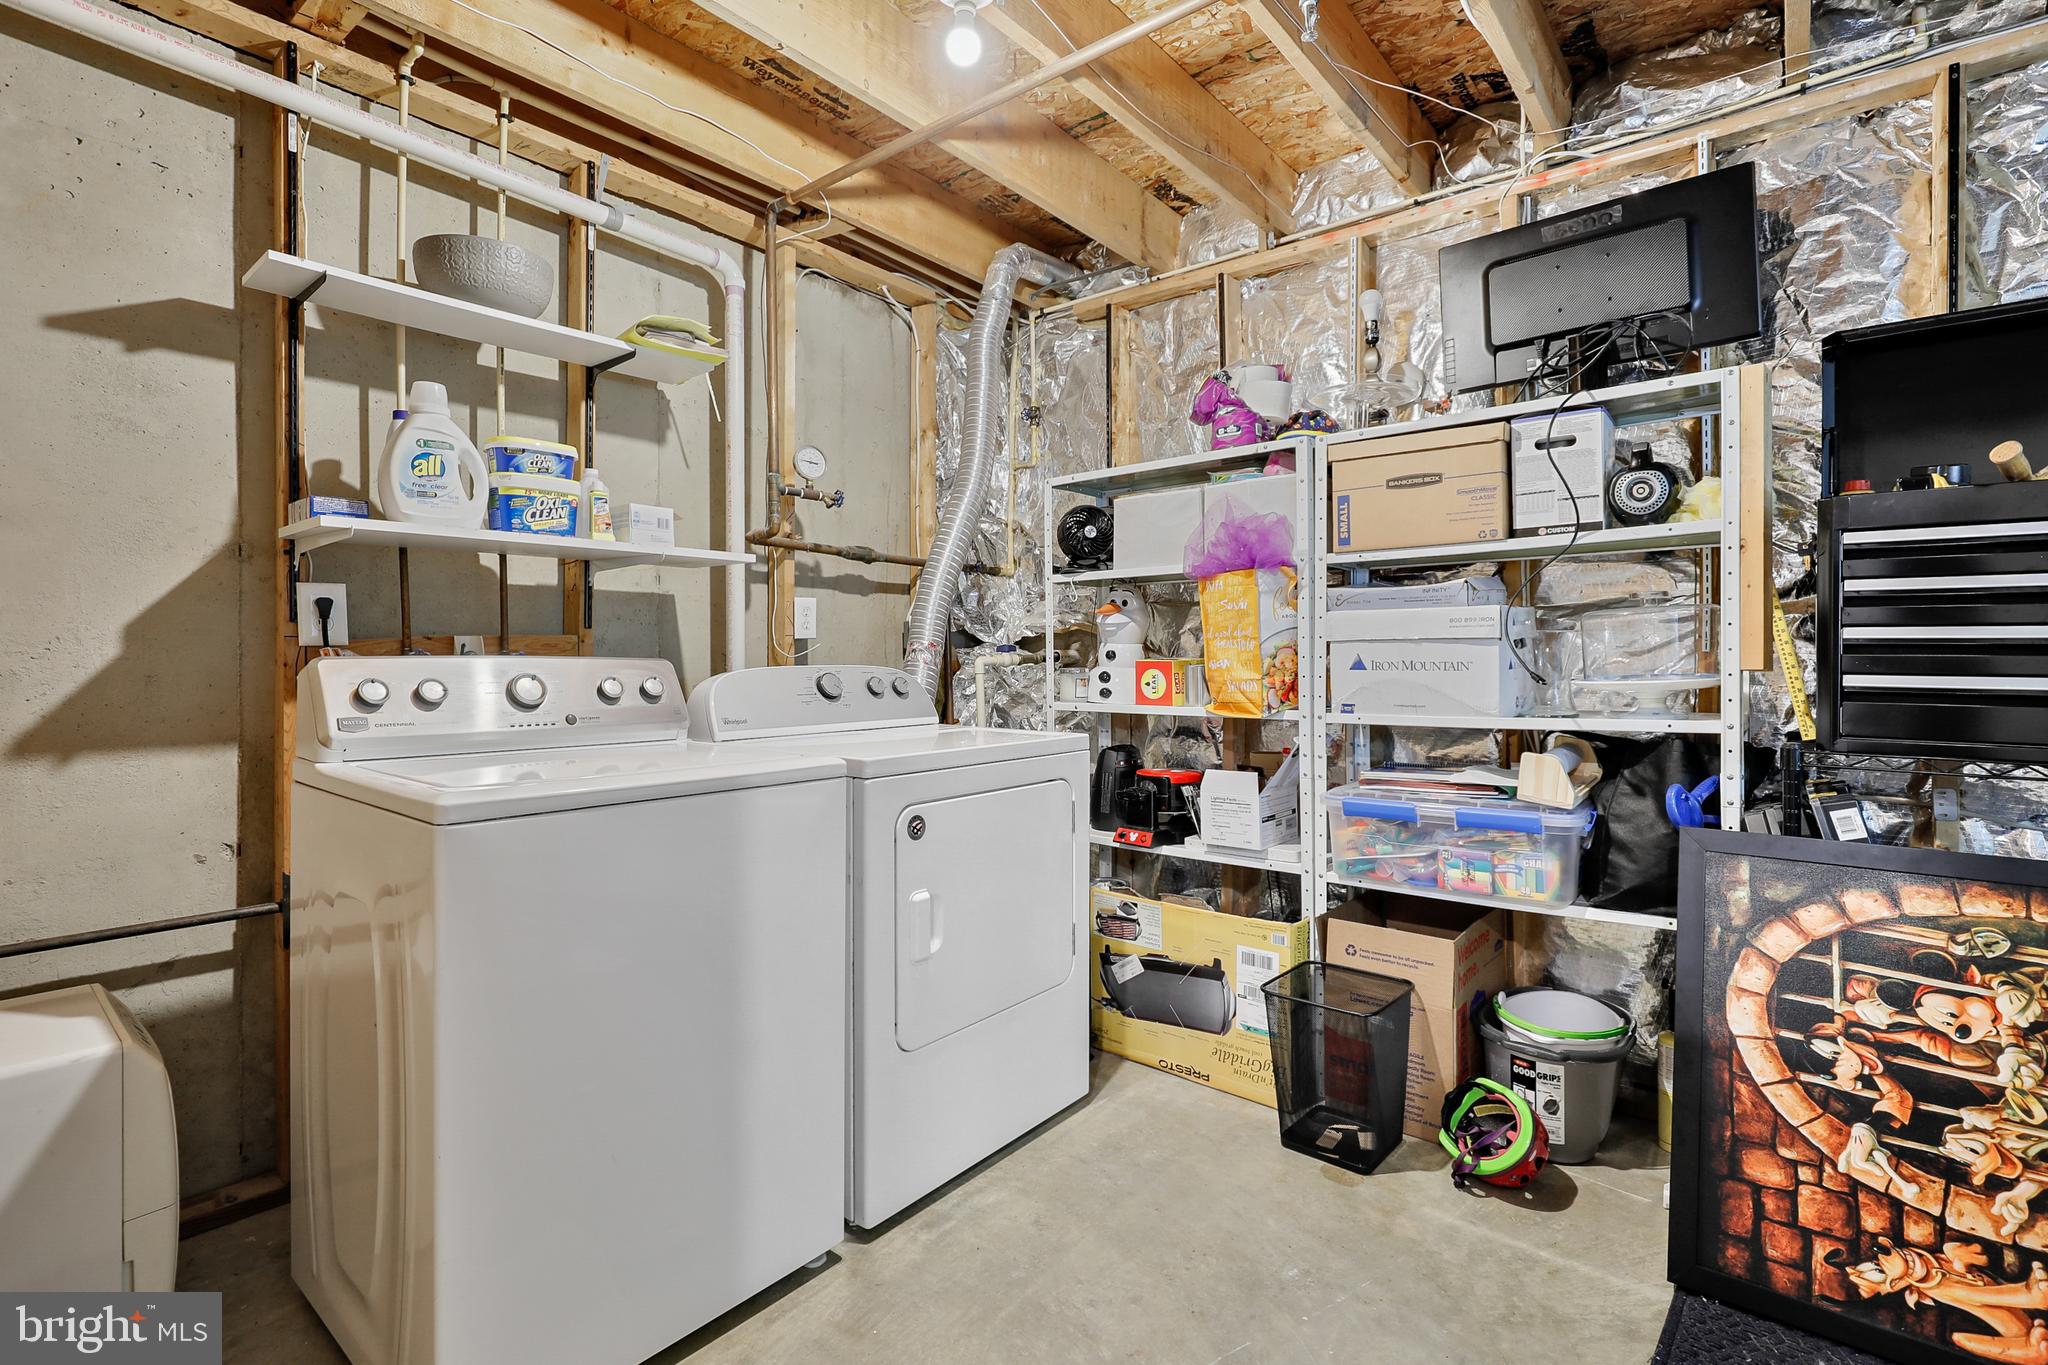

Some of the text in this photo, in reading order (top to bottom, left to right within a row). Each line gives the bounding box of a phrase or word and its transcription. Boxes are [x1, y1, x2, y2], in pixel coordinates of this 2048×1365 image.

[741, 56, 851, 121] Weyerhaeuser
[412, 453, 443, 477] all
[527, 459, 553, 468] CLEAN
[411, 481, 427, 489] free
[1388, 474, 1441, 487] BANKERS BOX
[536, 496, 560, 509] OXI
[525, 506, 567, 523] CLEAN
[1339, 502, 1349, 540] SMALL
[1547, 526, 1576, 534] CUSTOM
[1371, 660, 1470, 672] IRON MOUNTAIN
[342, 718, 368, 727] MAYTAG
[722, 718, 748, 726] Whirlpool
[1458, 929, 1490, 966] Welcome
[1458, 962, 1480, 992] home.
[1158, 1059, 1210, 1082] PRESTO
[1513, 1064, 1562, 1082] GOOD GRIPS
